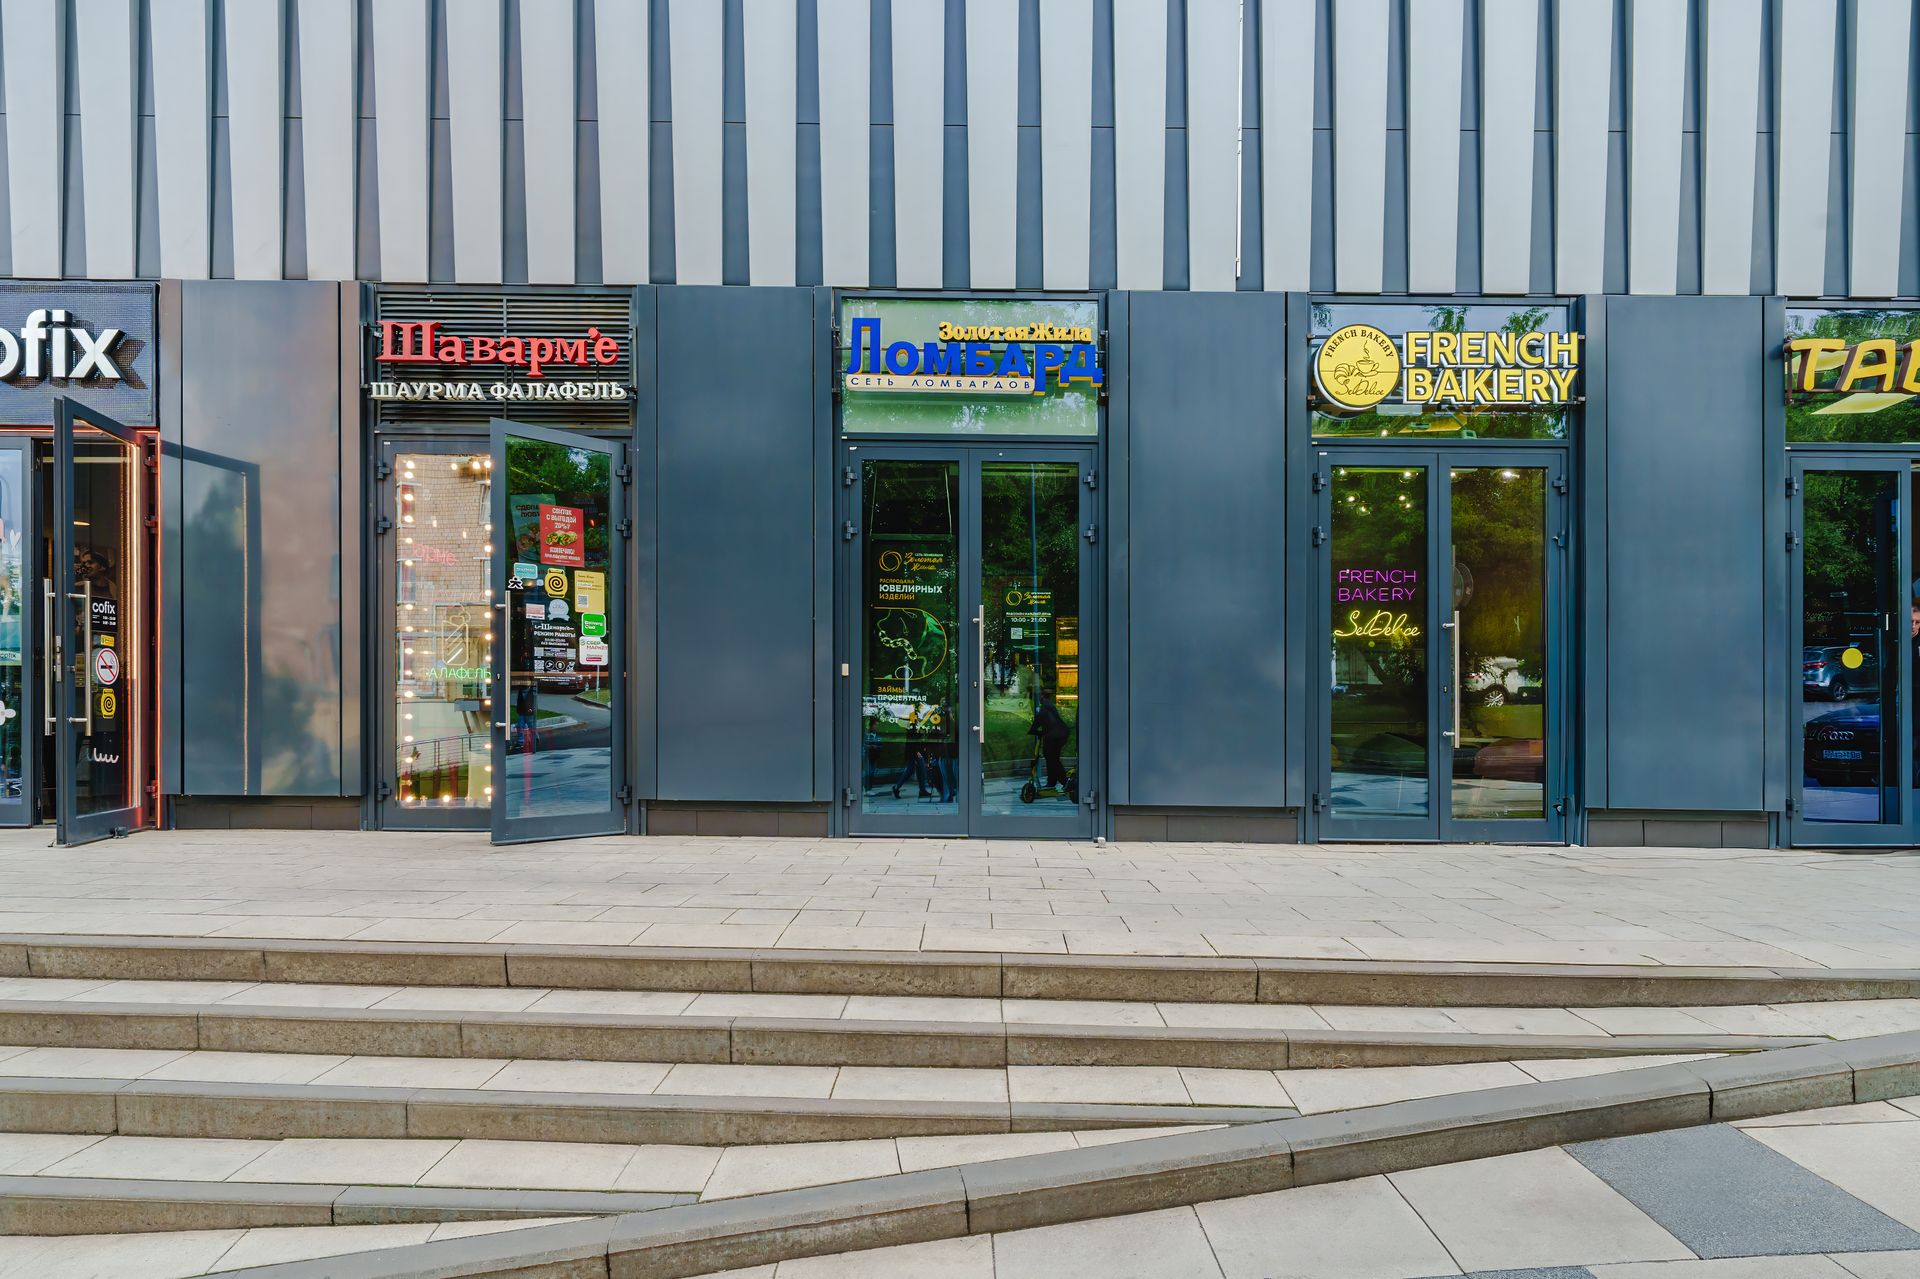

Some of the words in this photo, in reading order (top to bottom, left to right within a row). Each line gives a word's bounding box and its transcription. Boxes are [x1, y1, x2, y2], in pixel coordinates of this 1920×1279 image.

[1325, 329, 1357, 358] FRENCH
[1360, 329, 1394, 358] BAKERY
[1404, 331, 1579, 367] FRENCH
[370, 381, 487, 400] ШАУРМА
[489, 381, 628, 400] ФАЛАФЕЛЬ
[850, 377, 894, 387] СЕТЬ
[911, 378, 1031, 390] ЛОМБАРДОВ
[1404, 368, 1578, 404] BAKERY
[1338, 569, 1417, 584] FRENCH
[880, 584, 943, 593] ЮВЕЛИРНЫХ
[1338, 587, 1416, 602] BAKERY
[92, 601, 116, 614] cofix
